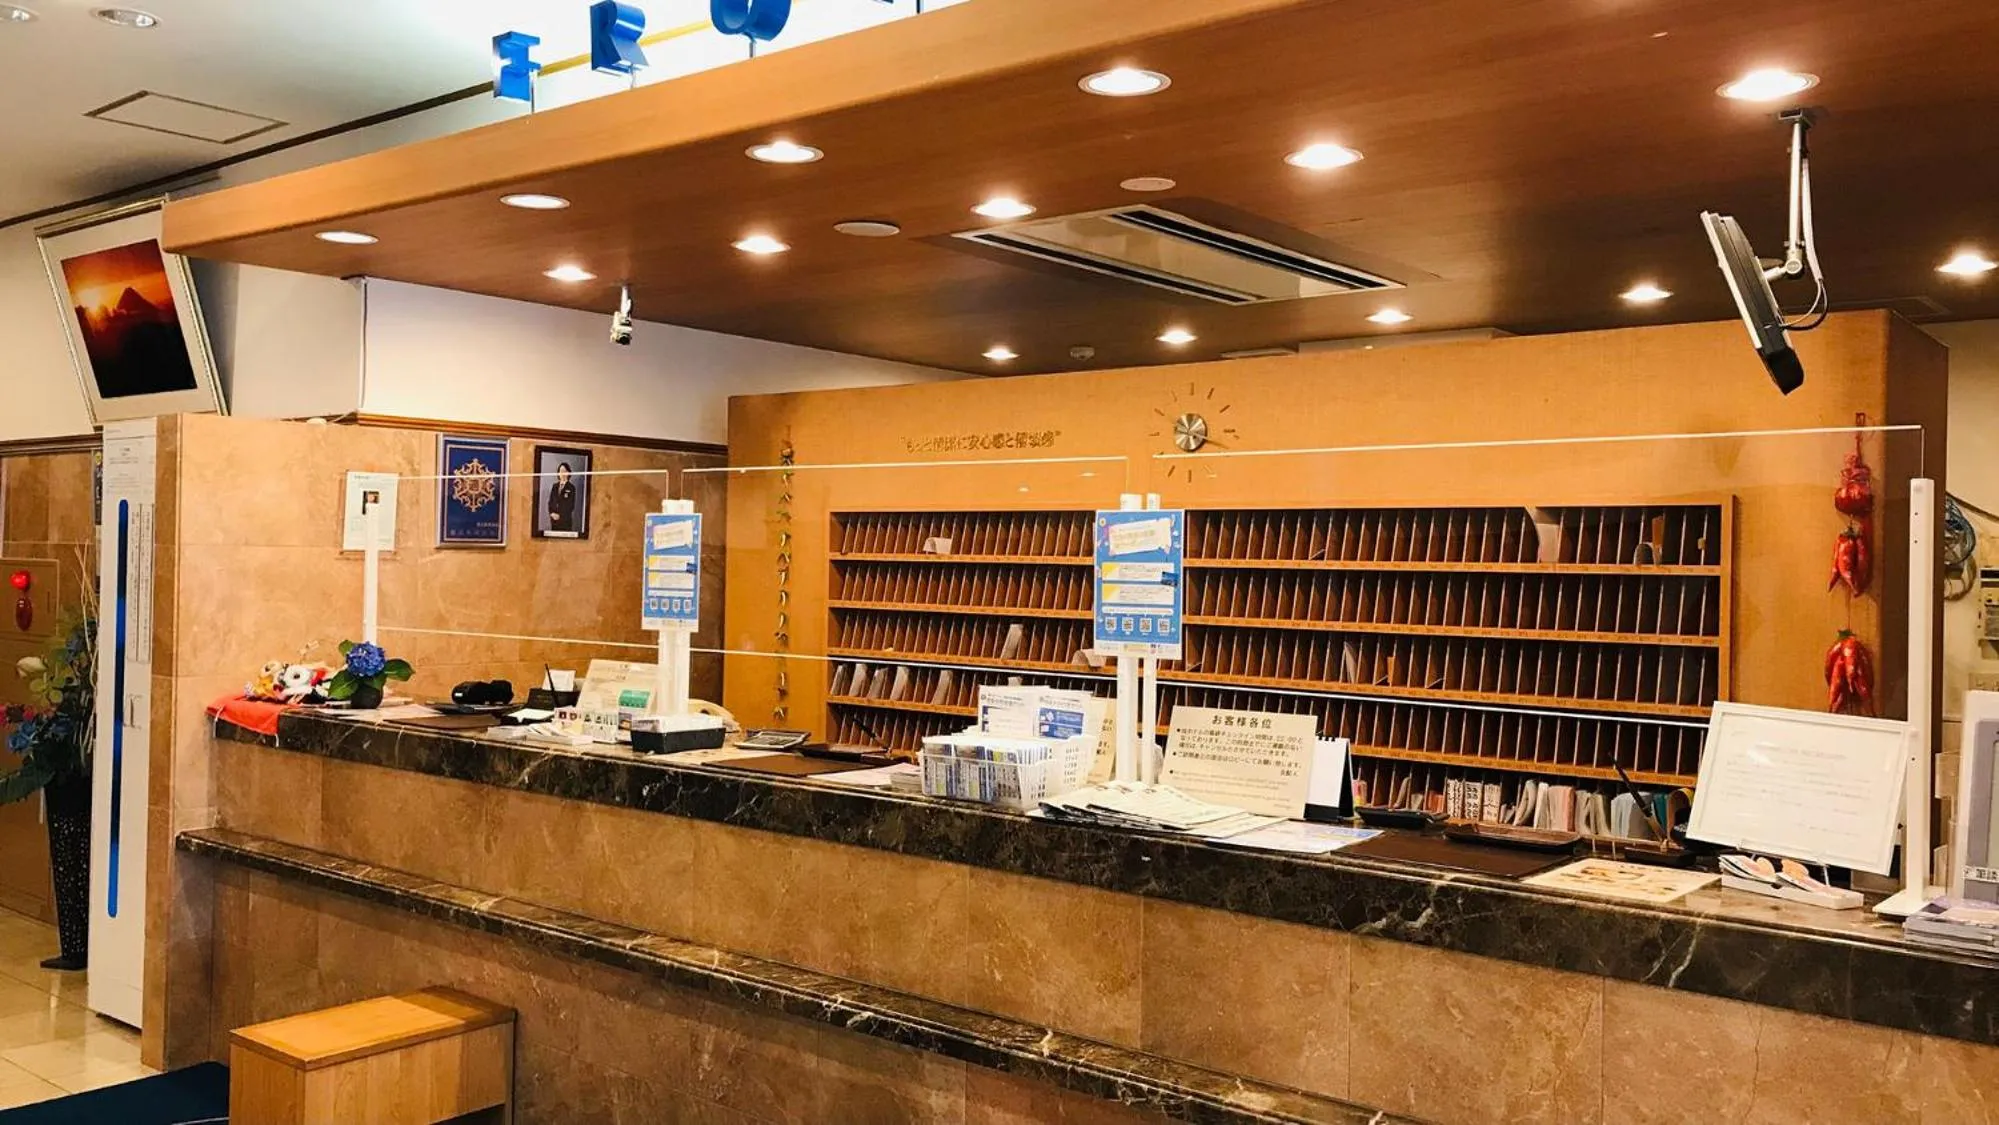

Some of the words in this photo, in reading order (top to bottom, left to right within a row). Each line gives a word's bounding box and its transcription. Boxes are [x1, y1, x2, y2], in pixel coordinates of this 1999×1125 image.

[1212, 715, 1272, 729] お客様各位
